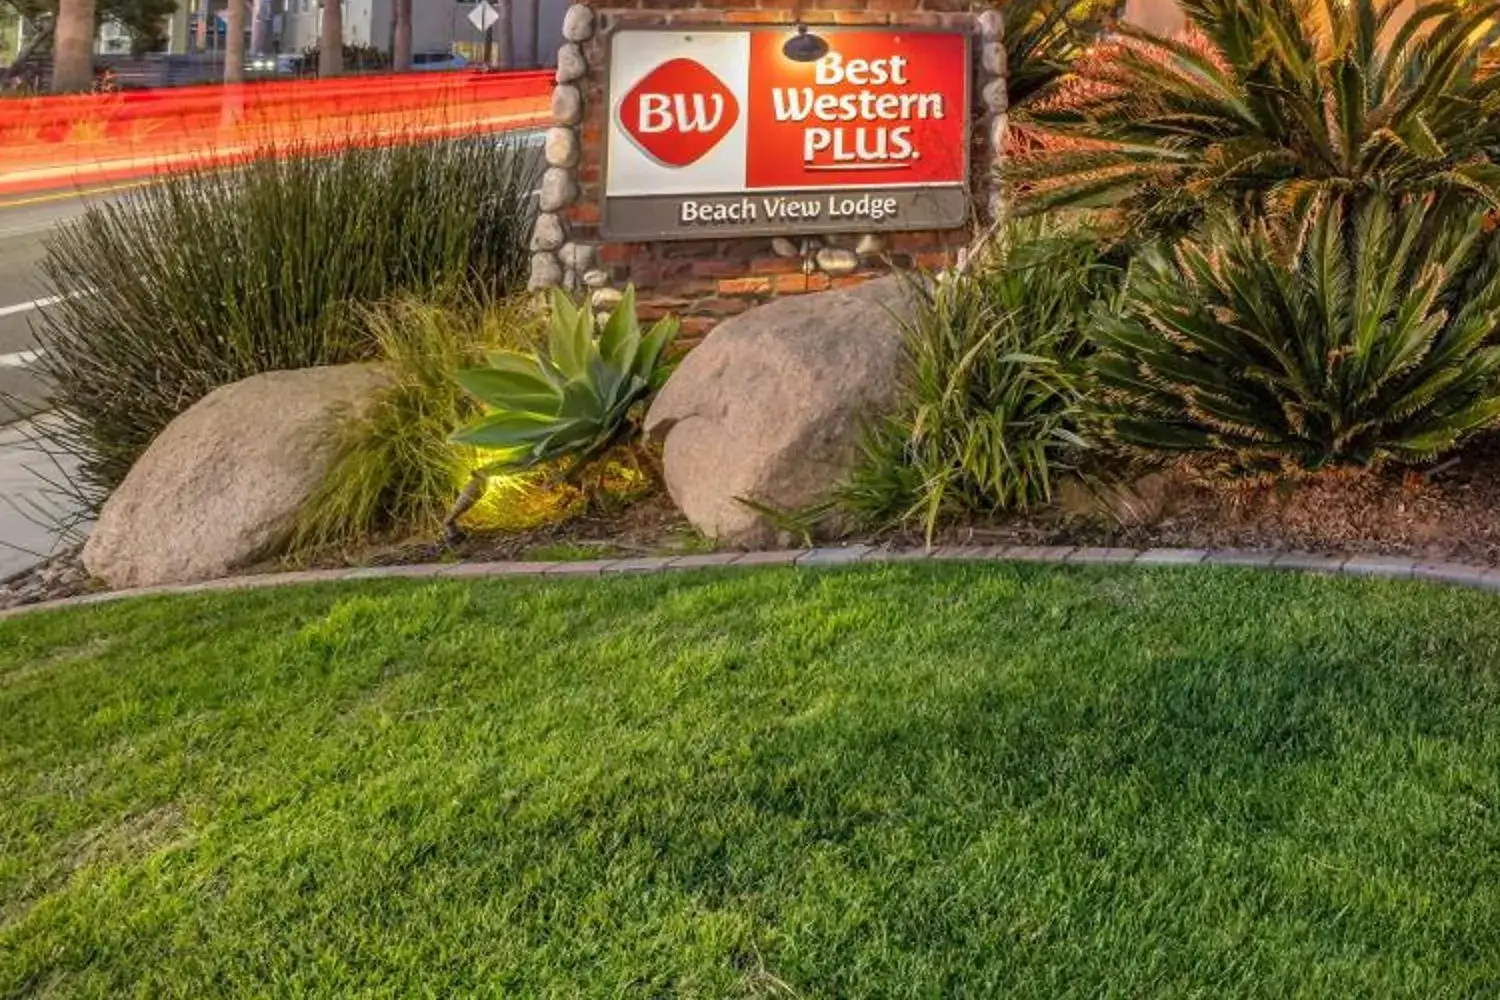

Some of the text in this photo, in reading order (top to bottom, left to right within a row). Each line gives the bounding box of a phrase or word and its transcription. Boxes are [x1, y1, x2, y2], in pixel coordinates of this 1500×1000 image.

[815, 52, 907, 85] Best
[638, 92, 723, 133] BW
[772, 87, 944, 121] Western
[681, 195, 898, 222] Beach View Lodge
